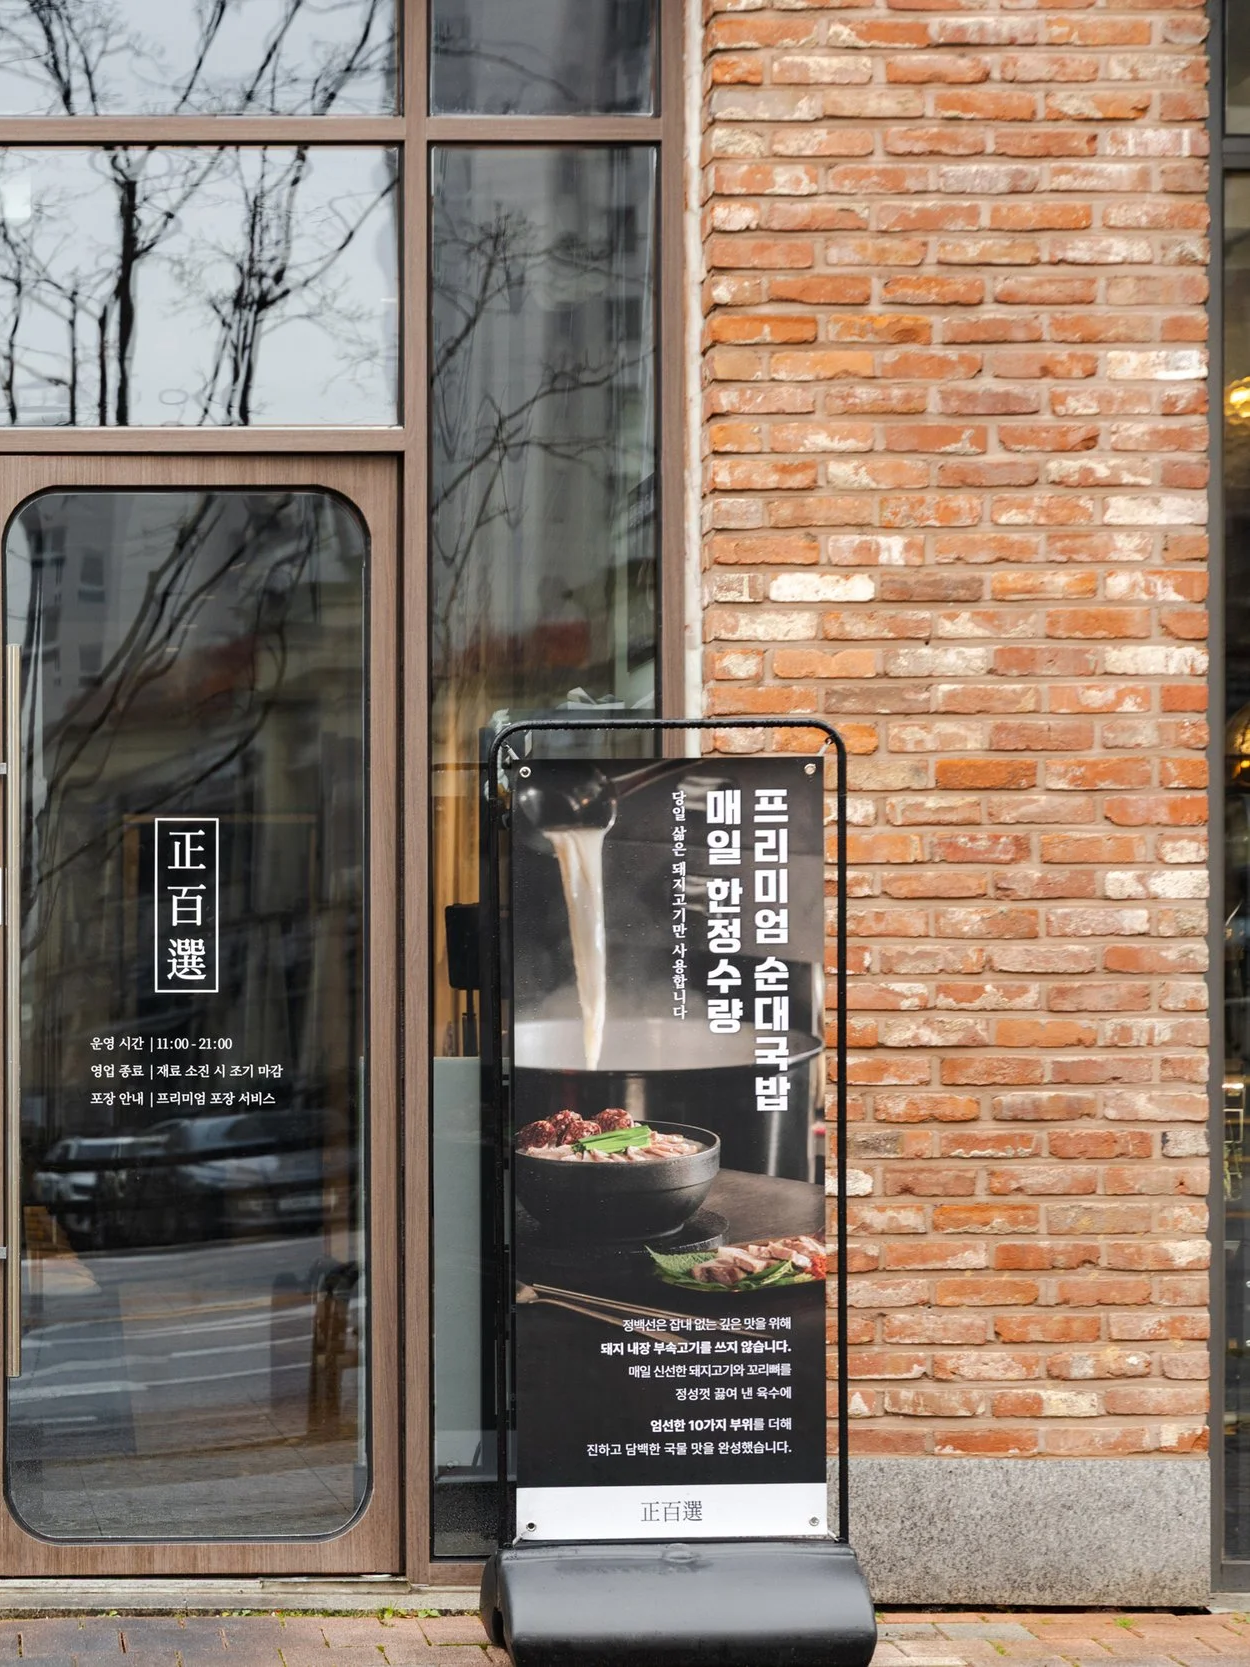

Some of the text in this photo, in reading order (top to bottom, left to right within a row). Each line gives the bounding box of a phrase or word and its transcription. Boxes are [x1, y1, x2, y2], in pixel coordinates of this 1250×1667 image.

[167, 830, 206, 979] 正百選
[672, 791, 688, 1019] 당일 삶은 돼지고기만 사용합니다
[707, 790, 742, 1033] 매일 한정수량
[754, 789, 791, 1112] 프리미엄 순대국밥
[90, 1037, 115, 1051] 운영
[119, 1037, 145, 1051] 시간
[157, 1038, 189, 1050] 11:00
[198, 1038, 233, 1050] 21:00
[90, 1064, 284, 1079] 영업 종료 재료 소진 시 조기 마감
[90, 1092, 276, 1106] 포장 안내 프리미엄 포장 서비스
[622, 1317, 792, 1332] 정백선은 잡내 없는 깊은 맛을 위해
[600, 1340, 792, 1356] 돼지 내장 부속고기를 쓰지 않습니다.
[628, 1364, 792, 1379] 매일 신선한 돼지고기와 꼬리뼈를
[675, 1387, 792, 1401] 정성껏 끓여 낸 육수에
[650, 1418, 792, 1433] 엄선한 10가지 부위를 더해
[586, 1441, 792, 1457] 진하고 담백한 국물 맛을 완성했습니다.
[640, 1500, 703, 1522] 正百選
